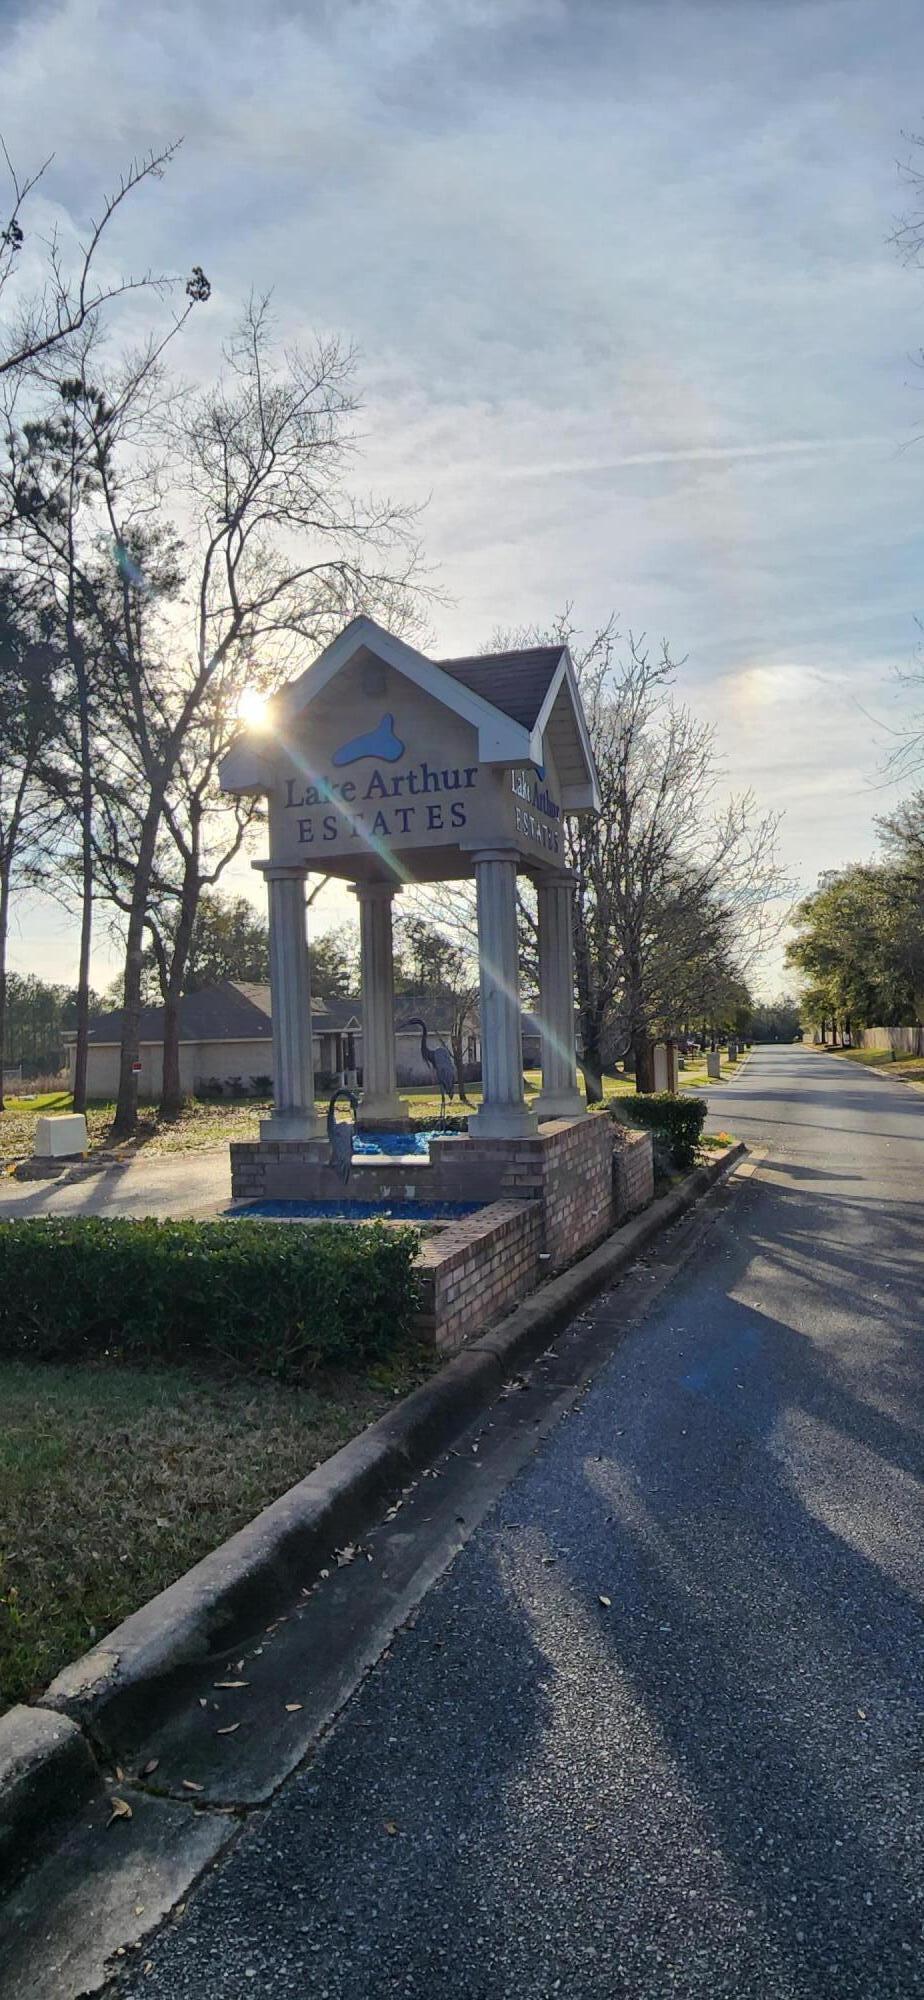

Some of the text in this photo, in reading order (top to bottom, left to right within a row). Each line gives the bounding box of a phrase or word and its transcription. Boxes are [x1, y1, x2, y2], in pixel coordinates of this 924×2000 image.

[285, 762, 478, 809] Lake Arthur
[297, 802, 468, 843] ESTATES
